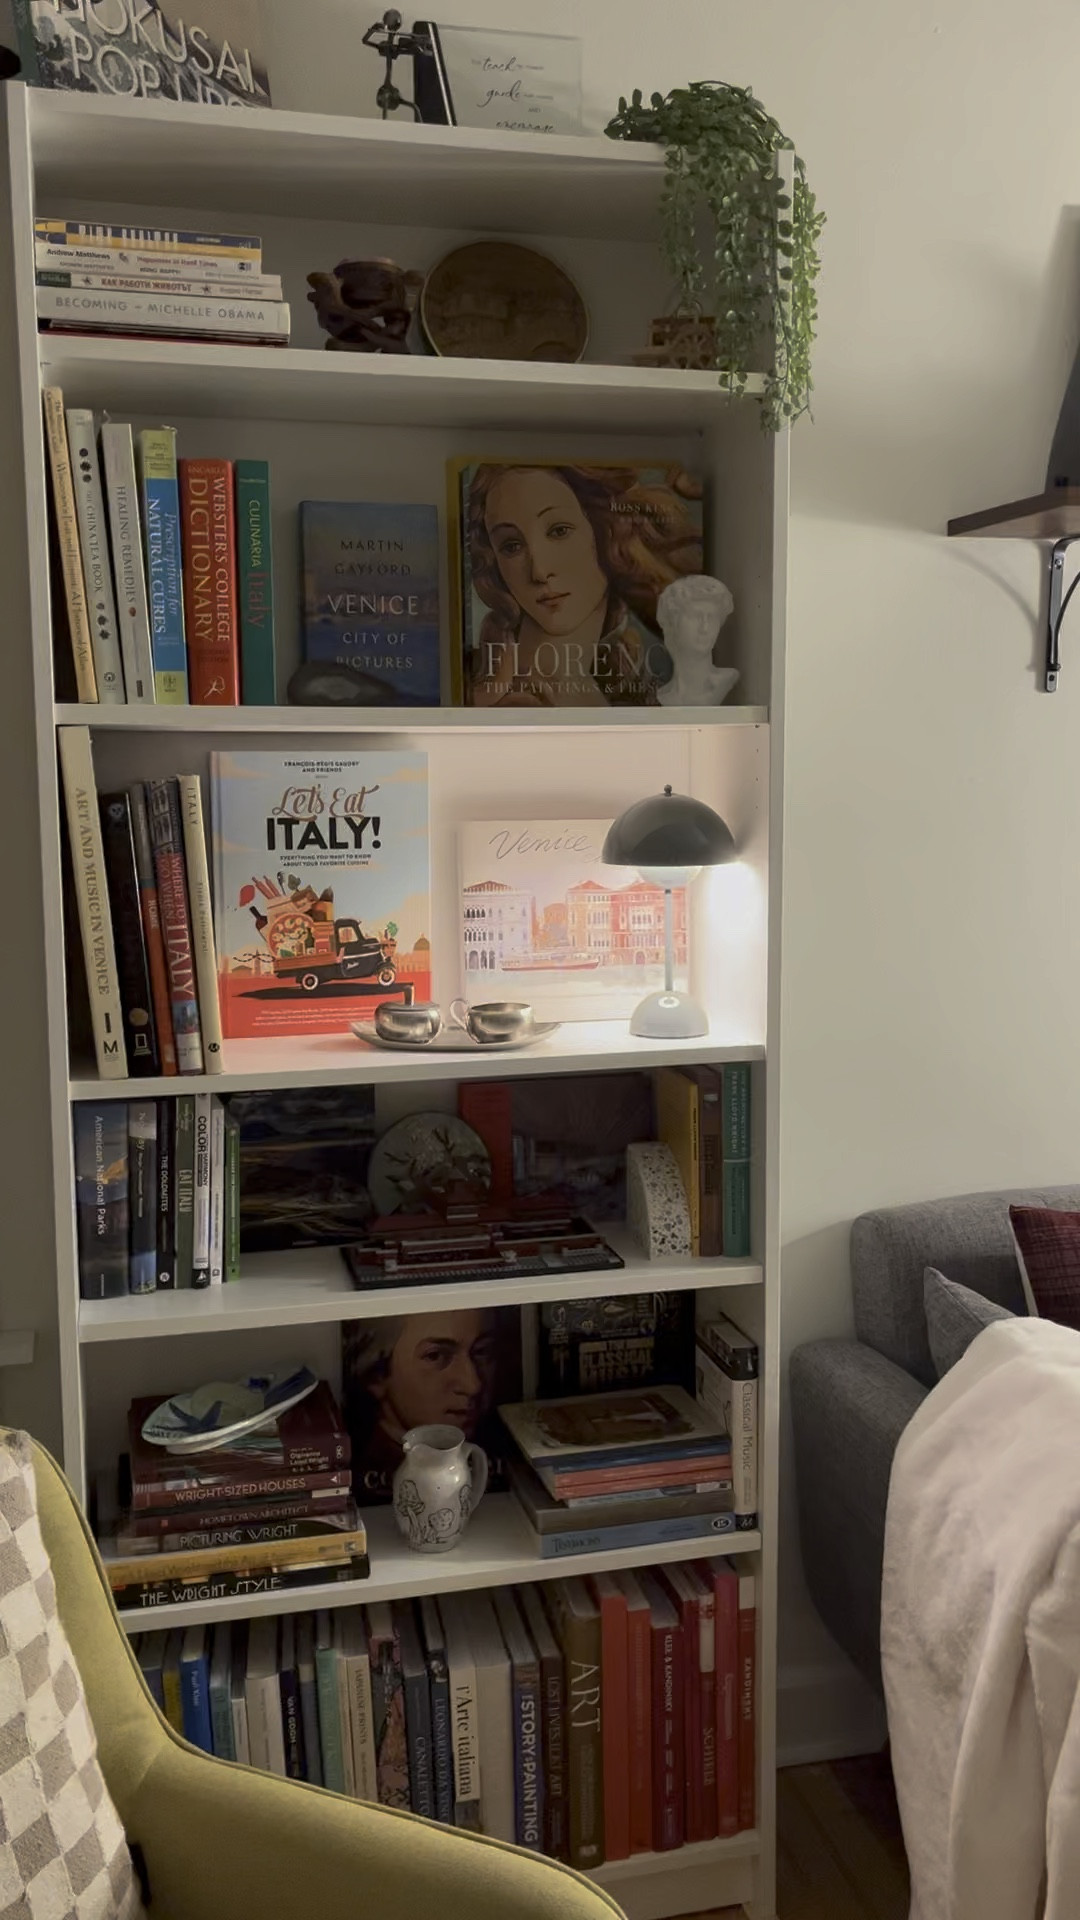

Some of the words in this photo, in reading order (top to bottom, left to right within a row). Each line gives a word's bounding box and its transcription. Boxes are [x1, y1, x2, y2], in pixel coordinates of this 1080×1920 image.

[54, 0, 255, 93] HOKUSAI
[75, 251, 110, 260] Matthews
[101, 278, 117, 286] КАК
[119, 279, 151, 288] РАБОТИ
[152, 282, 192, 292] ЖИВОТЪТ
[55, 296, 129, 312] BECOMING
[147, 304, 212, 318] MICHELLE
[218, 308, 265, 321] OBAMA
[85, 505, 98, 539] CHINA
[116, 486, 131, 540] HEALING
[213, 477, 229, 563] WEBSTER'S
[611, 503, 640, 512] ROSS
[89, 541, 101, 561] TEA
[147, 497, 165, 576] NATURAL
[248, 499, 262, 568] CULINARIA
[340, 540, 404, 552] MARTIN
[164, 513, 179, 594] Prescription
[189, 477, 213, 642] DICTIONARY
[334, 563, 411, 576] GAYFORD
[92, 563, 104, 592] BOOK
[121, 544, 136, 603] REMEDIES
[151, 579, 166, 633] CURES
[168, 597, 179, 616] for
[215, 568, 230, 641] COLLEGE
[247, 572, 269, 630] Italy
[327, 594, 419, 616] VENICE
[342, 633, 379, 644] CITY
[387, 633, 408, 645] OF
[336, 656, 413, 668] PICTURES
[486, 642, 665, 677] FLORENC
[485, 682, 513, 693] THE
[520, 681, 600, 693] PAINTINGS
[605, 684, 613, 693] &
[619, 682, 657, 693] FRES
[75, 787, 88, 822] ART
[187, 787, 198, 825] ITALY
[272, 784, 324, 822] Let's
[329, 785, 379, 820] Eat
[78, 824, 94, 859] AND
[266, 816, 382, 850] ITALY!
[488, 829, 592, 859] Venice
[160, 858, 170, 880] GO
[171, 857, 184, 900] WHERE
[84, 863, 103, 911] MUSIC
[162, 882, 176, 921] WHEN
[91, 913, 106, 932] IN
[175, 902, 186, 920] TO
[92, 934, 111, 995] VENICE
[167, 924, 195, 997] ITALY
[95, 1116, 105, 1162] American
[198, 1116, 206, 1152] COLOR
[96, 1165, 105, 1205] National
[160, 1171, 168, 1212] DOLOMITES
[179, 1169, 192, 1186] EAT
[179, 1188, 193, 1212] ITALY
[97, 1208, 106, 1235] Parks
[742, 1382, 754, 1432] Classical
[742, 1437, 753, 1472] Music
[259, 1478, 306, 1492] HOUSES
[180, 1530, 243, 1547] PICTURING
[247, 1523, 298, 1540] WRIGHT
[140, 1592, 168, 1607] THE
[230, 1577, 283, 1595] STYLE
[664, 1633, 672, 1655] KLEE
[287, 1696, 295, 1715] VAN
[570, 1660, 601, 1732] ART
[664, 1664, 673, 1712] KANDINSKY
[456, 1686, 472, 1731] l'Arte
[288, 1716, 296, 1743] GOGH
[435, 1698, 448, 1767] LEONARDO
[521, 1700, 537, 1756] STORY
[416, 1736, 430, 1815] CANALETTO
[439, 1771, 449, 1790] DA
[458, 1736, 475, 1795] italiana
[439, 1792, 450, 1822] VINC
[523, 1762, 538, 1841] PAINTING
